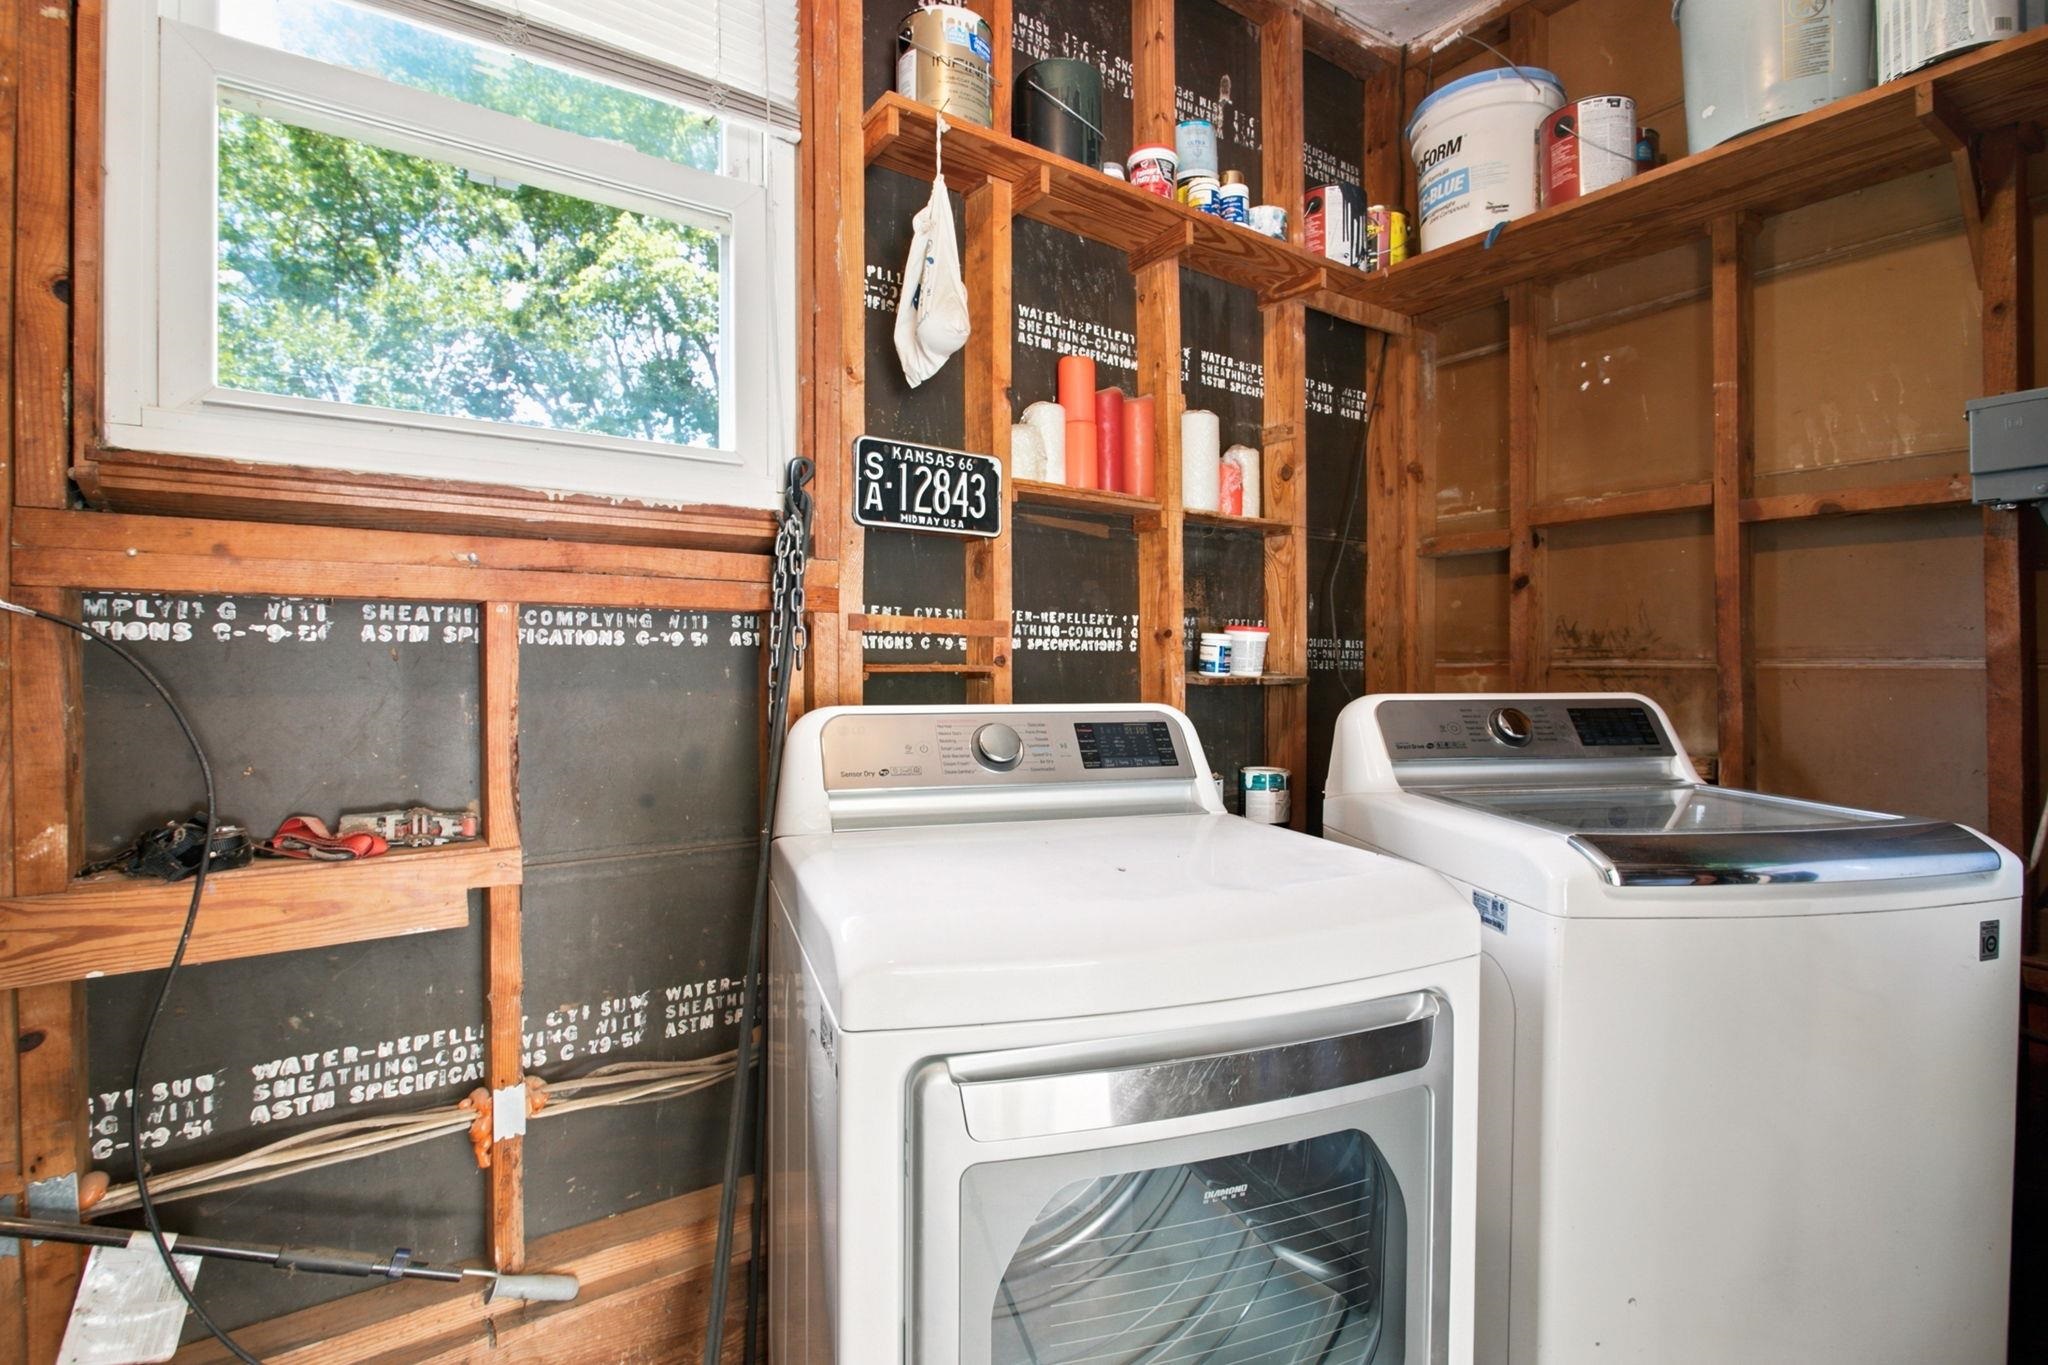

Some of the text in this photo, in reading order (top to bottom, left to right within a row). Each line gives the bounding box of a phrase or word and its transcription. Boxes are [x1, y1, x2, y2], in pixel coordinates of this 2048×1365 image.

[891, 446, 973, 471] KANSAS 66
[898, 462, 986, 519] 12843
[900, 513, 964, 529] MIDWAY USA
[361, 624, 430, 643] ASTM
[664, 1013, 714, 1039] ASTM
[250, 1089, 336, 1125] ASTM
[1203, 1184, 1248, 1200] DIAMOND
